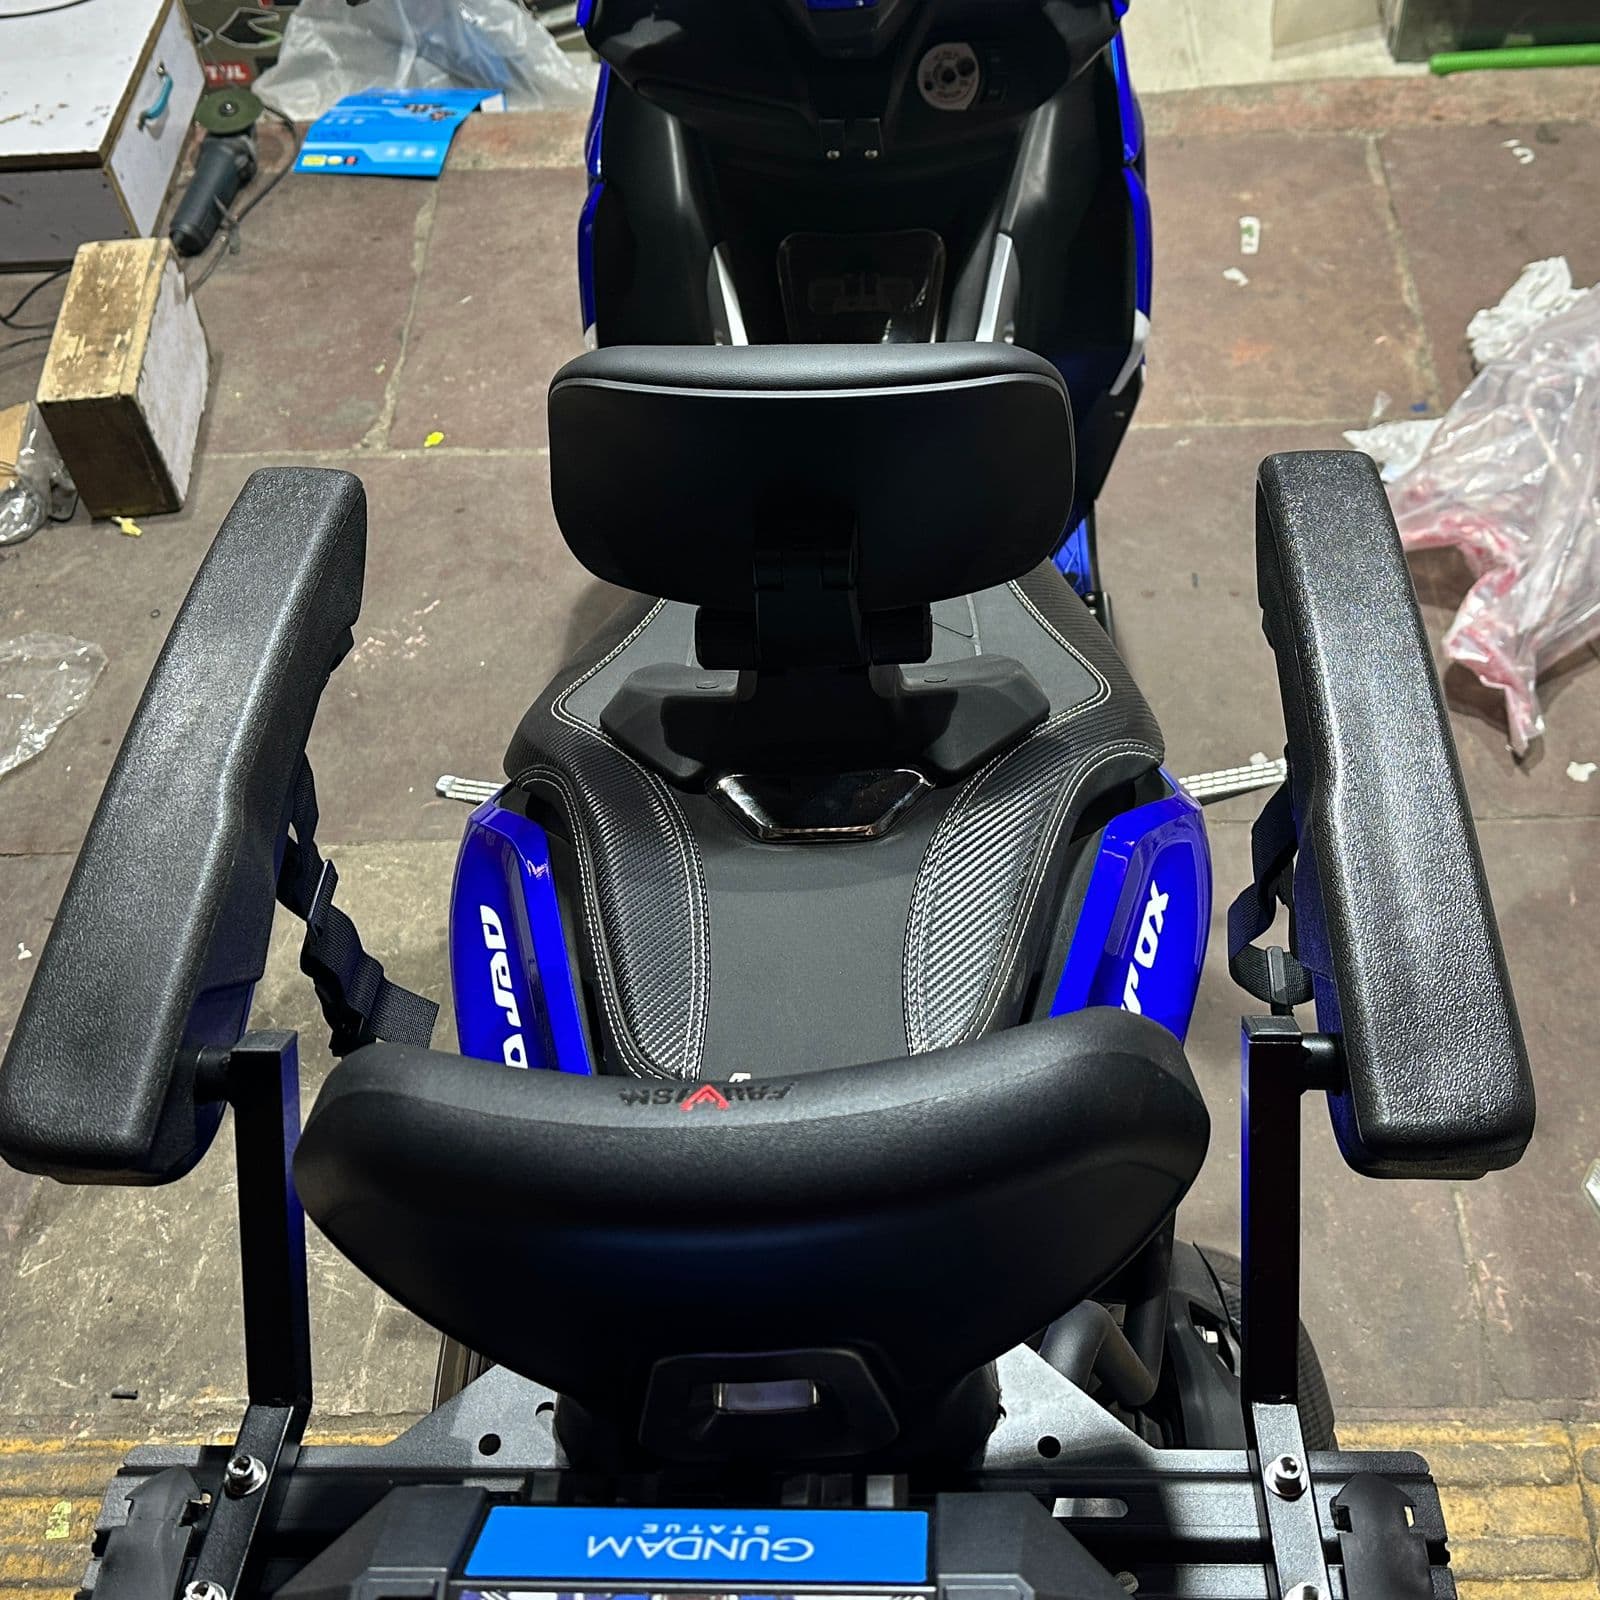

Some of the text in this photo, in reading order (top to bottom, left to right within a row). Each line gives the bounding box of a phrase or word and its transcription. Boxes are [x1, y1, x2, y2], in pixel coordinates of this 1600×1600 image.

[479, 904, 529, 1069] Aero
[1120, 879, 1170, 1016] rox
[587, 1535, 815, 1563] GUNDAM
[642, 1523, 770, 1535] STATUE
